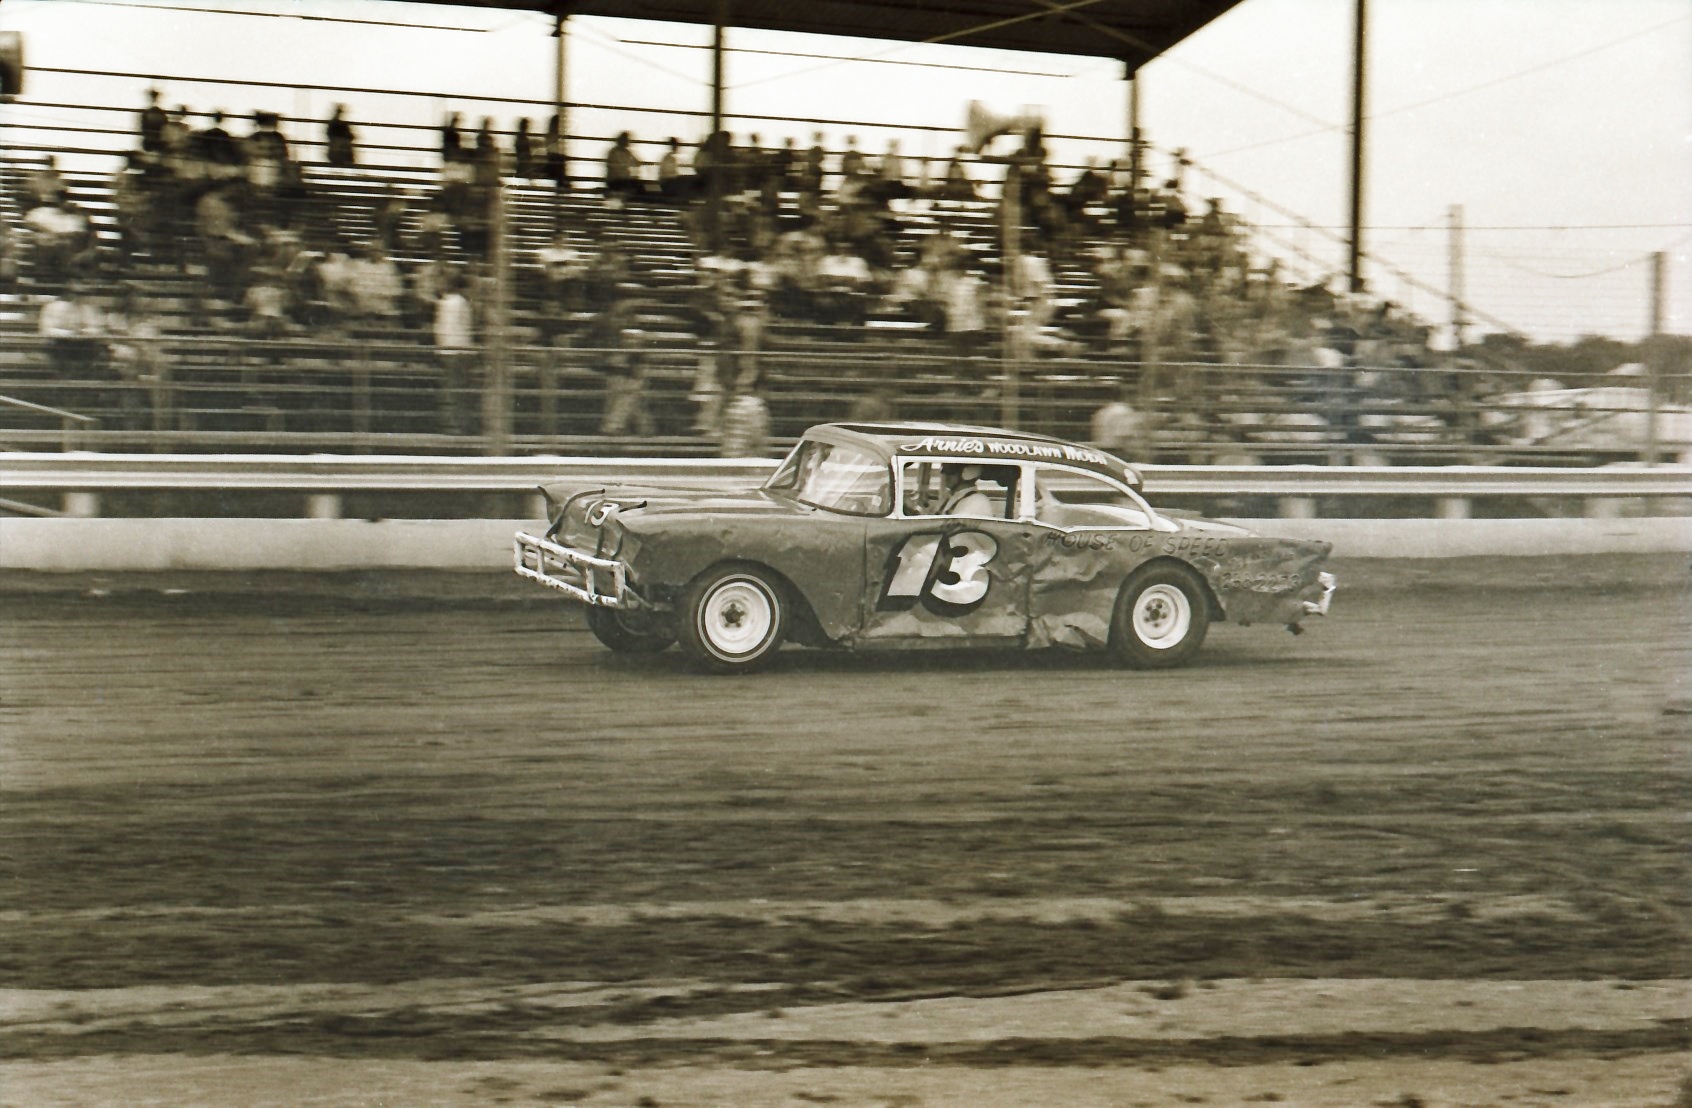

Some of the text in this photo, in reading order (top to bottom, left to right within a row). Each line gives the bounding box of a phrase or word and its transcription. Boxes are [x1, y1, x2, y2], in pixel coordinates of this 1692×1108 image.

[584, 500, 620, 527] 13
[1045, 531, 1117, 551] HOUSE
[1128, 535, 1154, 553] OF
[1162, 536, 1229, 557] SPEED
[882, 530, 998, 608] 13
